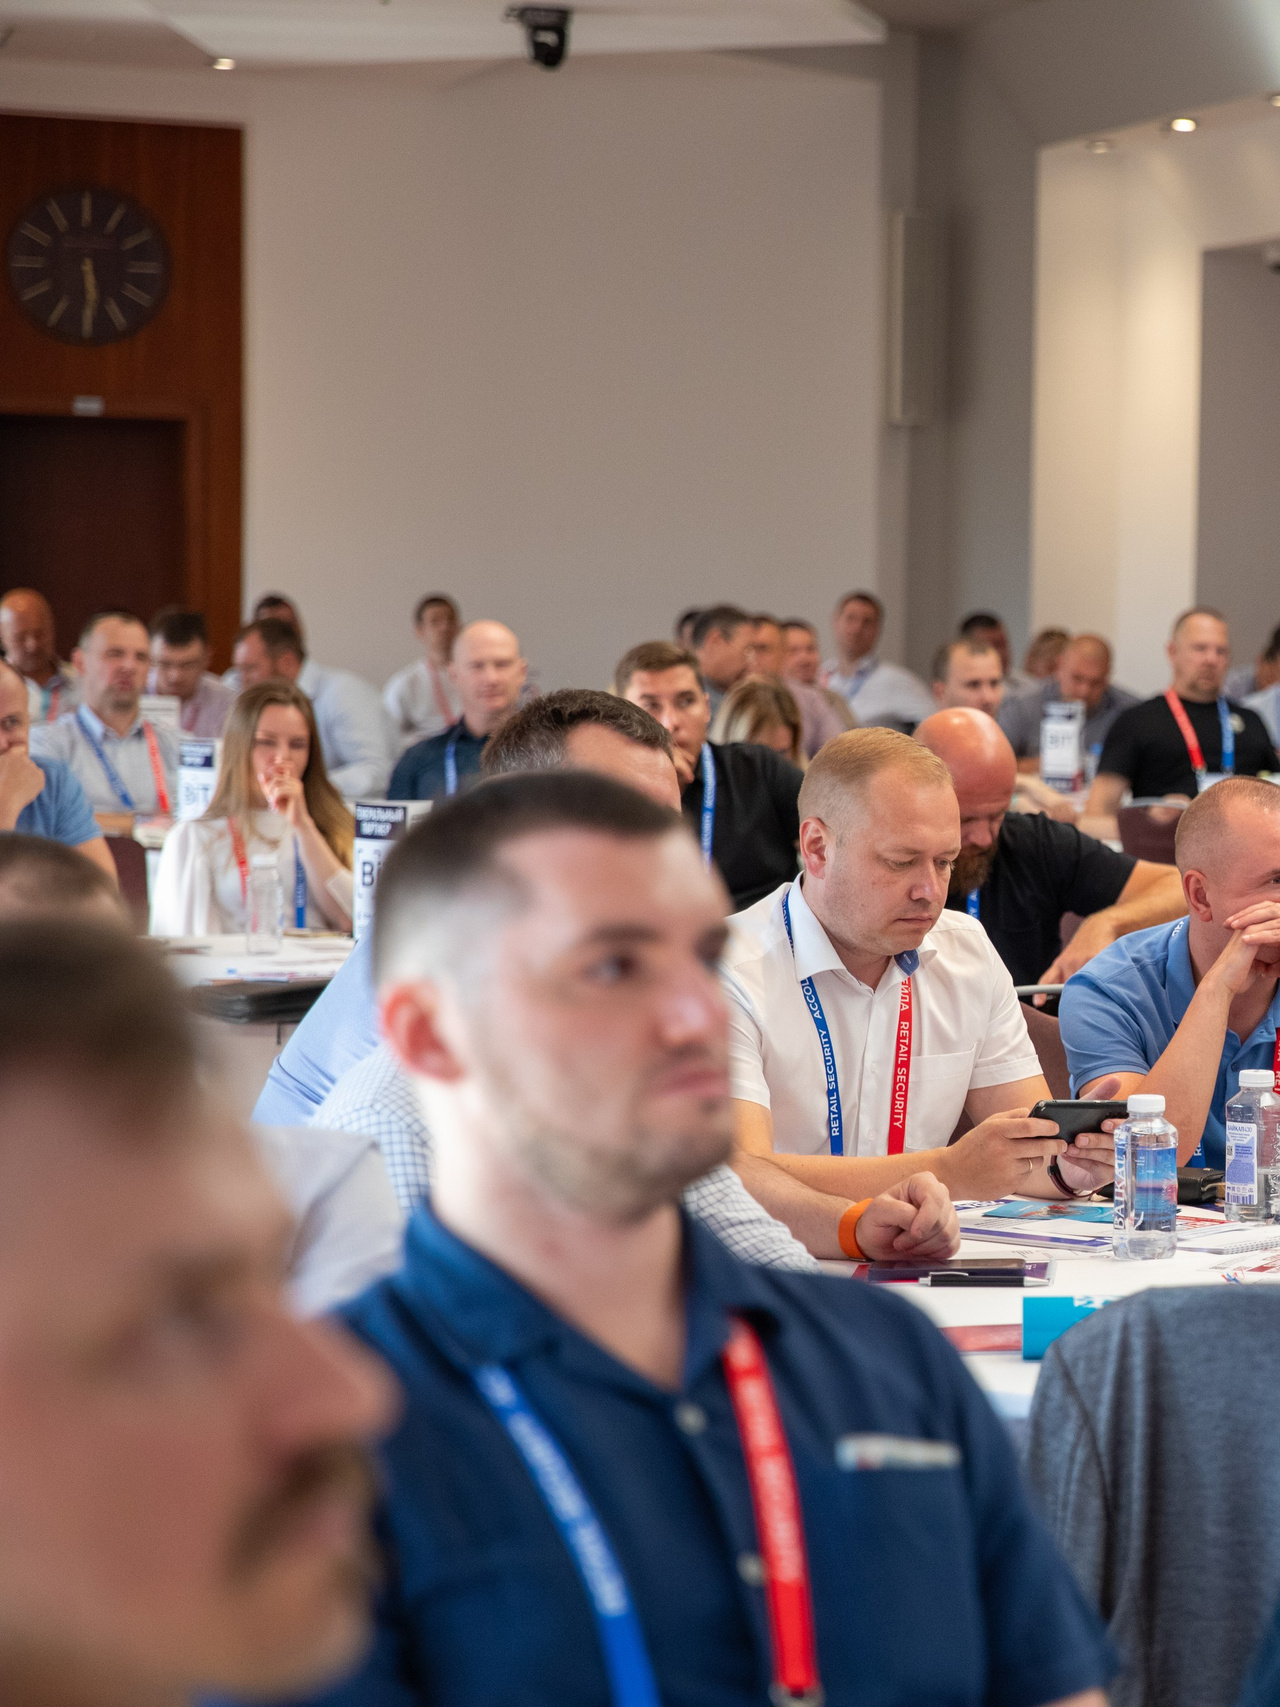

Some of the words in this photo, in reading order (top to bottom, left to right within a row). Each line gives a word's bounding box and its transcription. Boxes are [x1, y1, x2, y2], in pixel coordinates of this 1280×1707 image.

[819, 1029, 836, 1090] SECURITY
[898, 1021, 910, 1064] RETAIL
[829, 1091, 840, 1136] RETAIL
[893, 1066, 907, 1129] SECURITY
